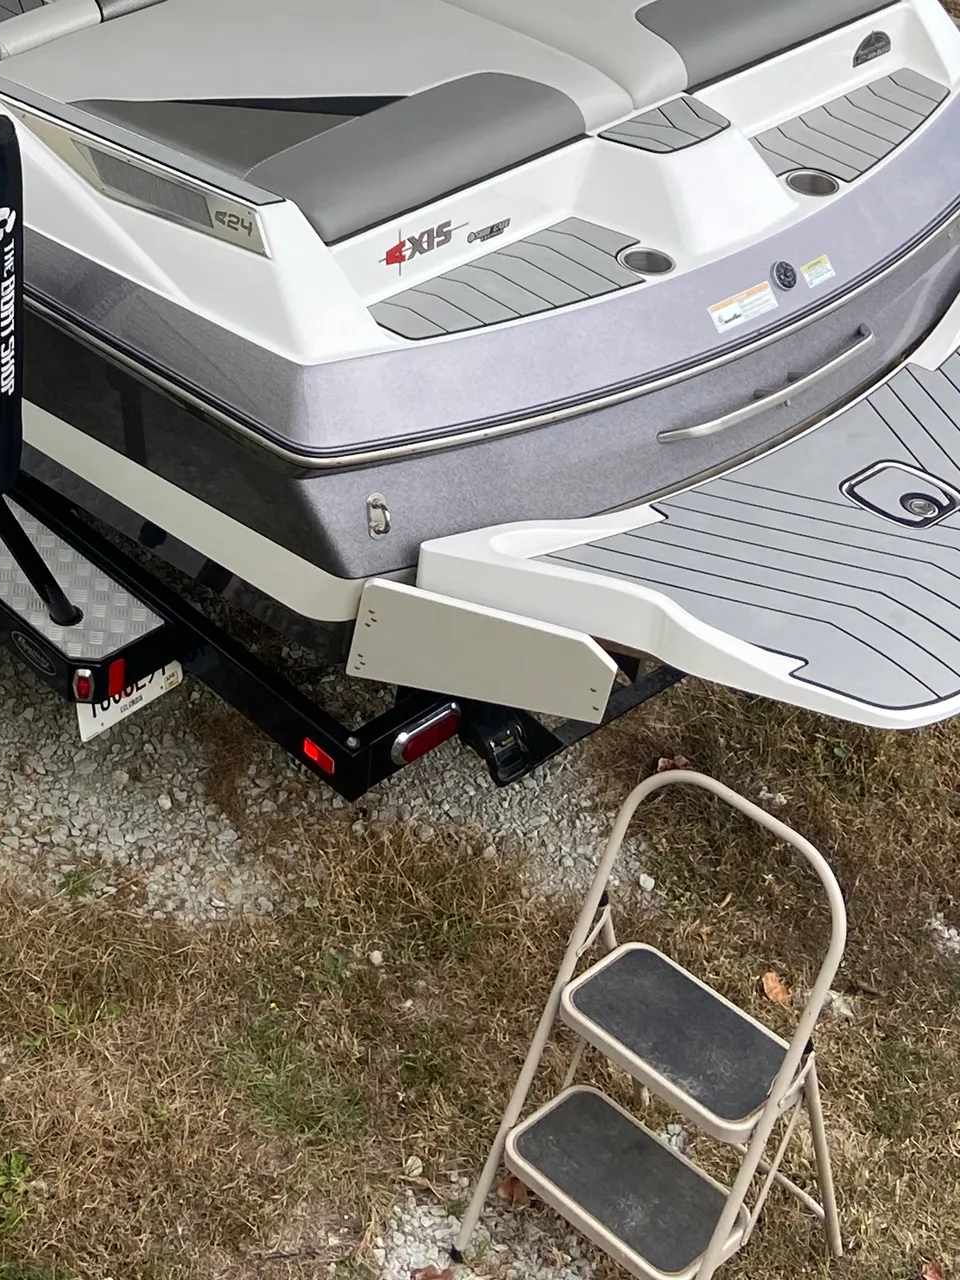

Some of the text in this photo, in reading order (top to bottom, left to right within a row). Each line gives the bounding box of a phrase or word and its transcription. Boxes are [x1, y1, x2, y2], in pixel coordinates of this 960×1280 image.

[0, 237, 15, 396] THE BOAT SHOP
